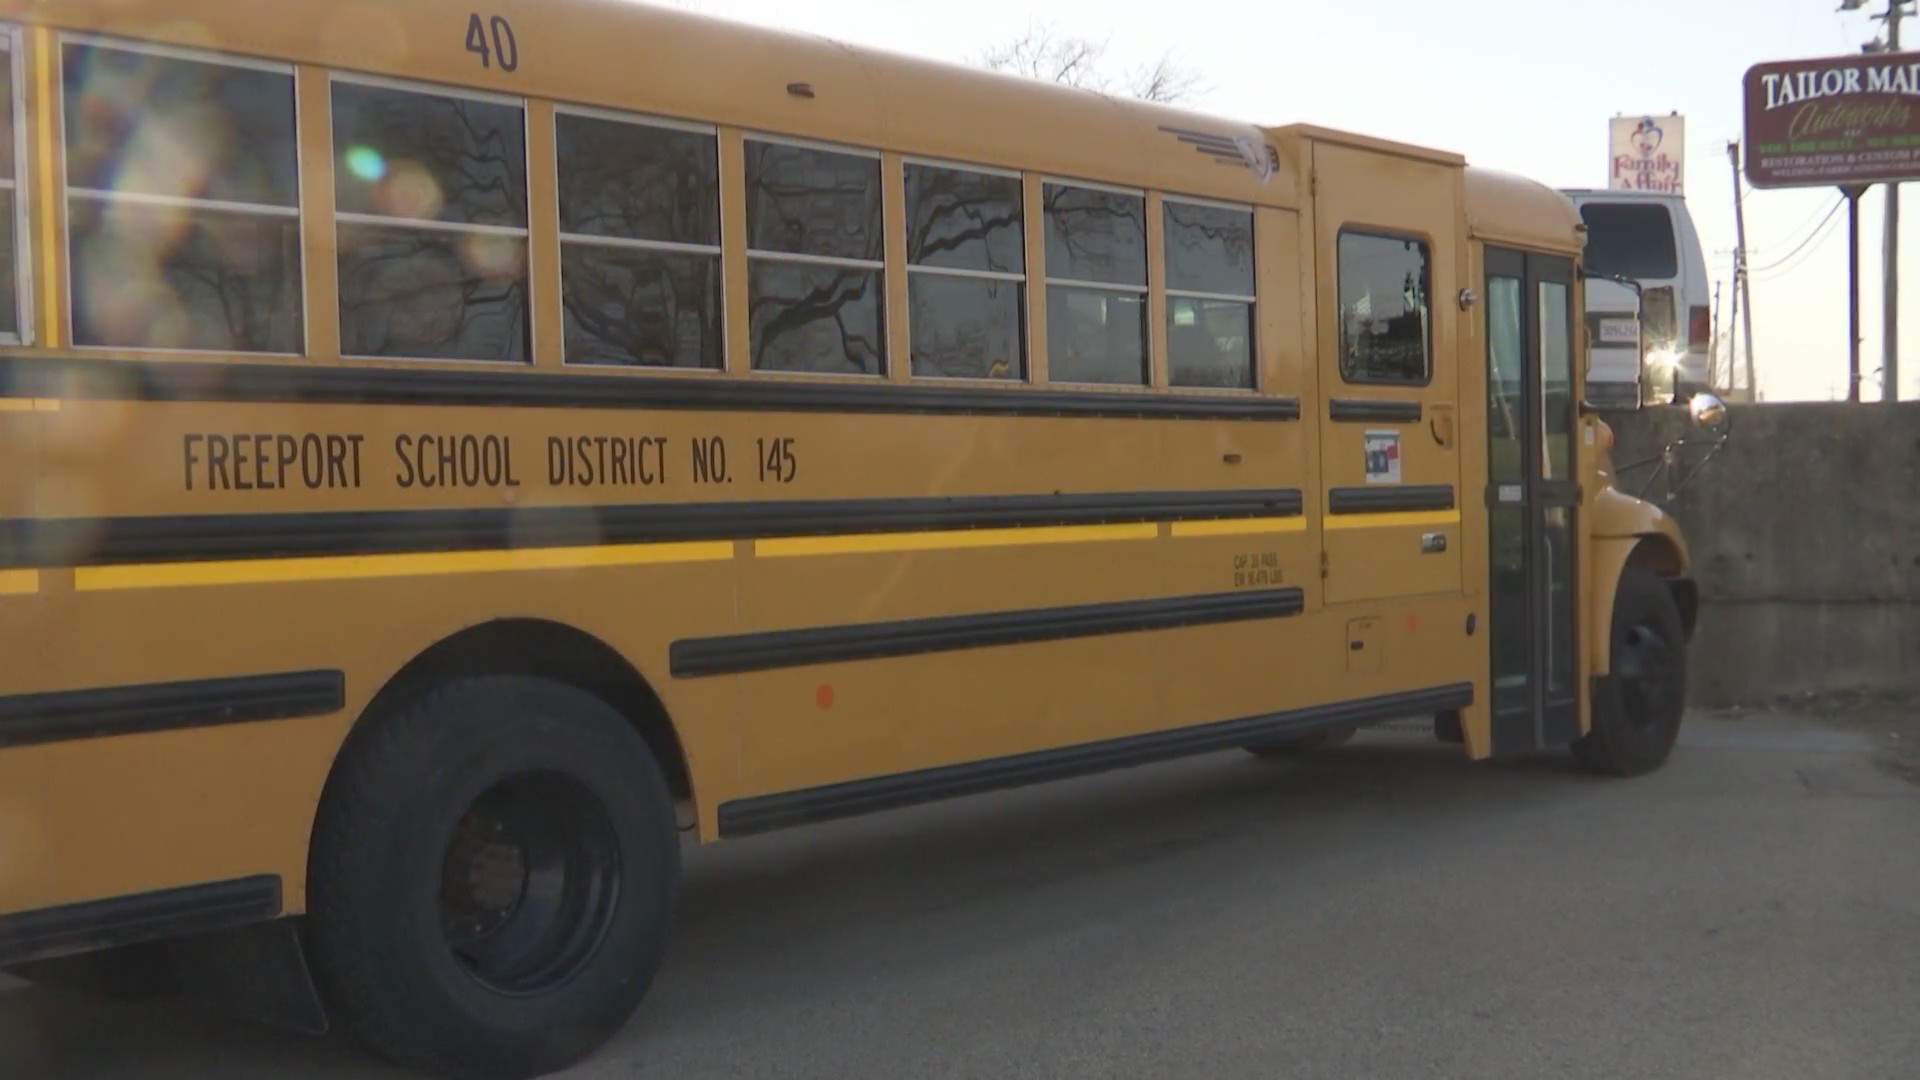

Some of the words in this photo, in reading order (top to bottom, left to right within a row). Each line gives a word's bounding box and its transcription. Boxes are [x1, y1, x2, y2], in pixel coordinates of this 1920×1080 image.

[465, 12, 518, 72] 40
[1761, 68, 1862, 110] TAILOR
[1613, 153, 1680, 181] Family
[1760, 154, 1845, 168] RESTORATION
[184, 433, 364, 491] FREEPORT
[395, 434, 520, 488] SCHOOL
[548, 436, 667, 486] DISTRICT
[692, 437, 732, 483] NO.
[757, 437, 796, 483] 145
